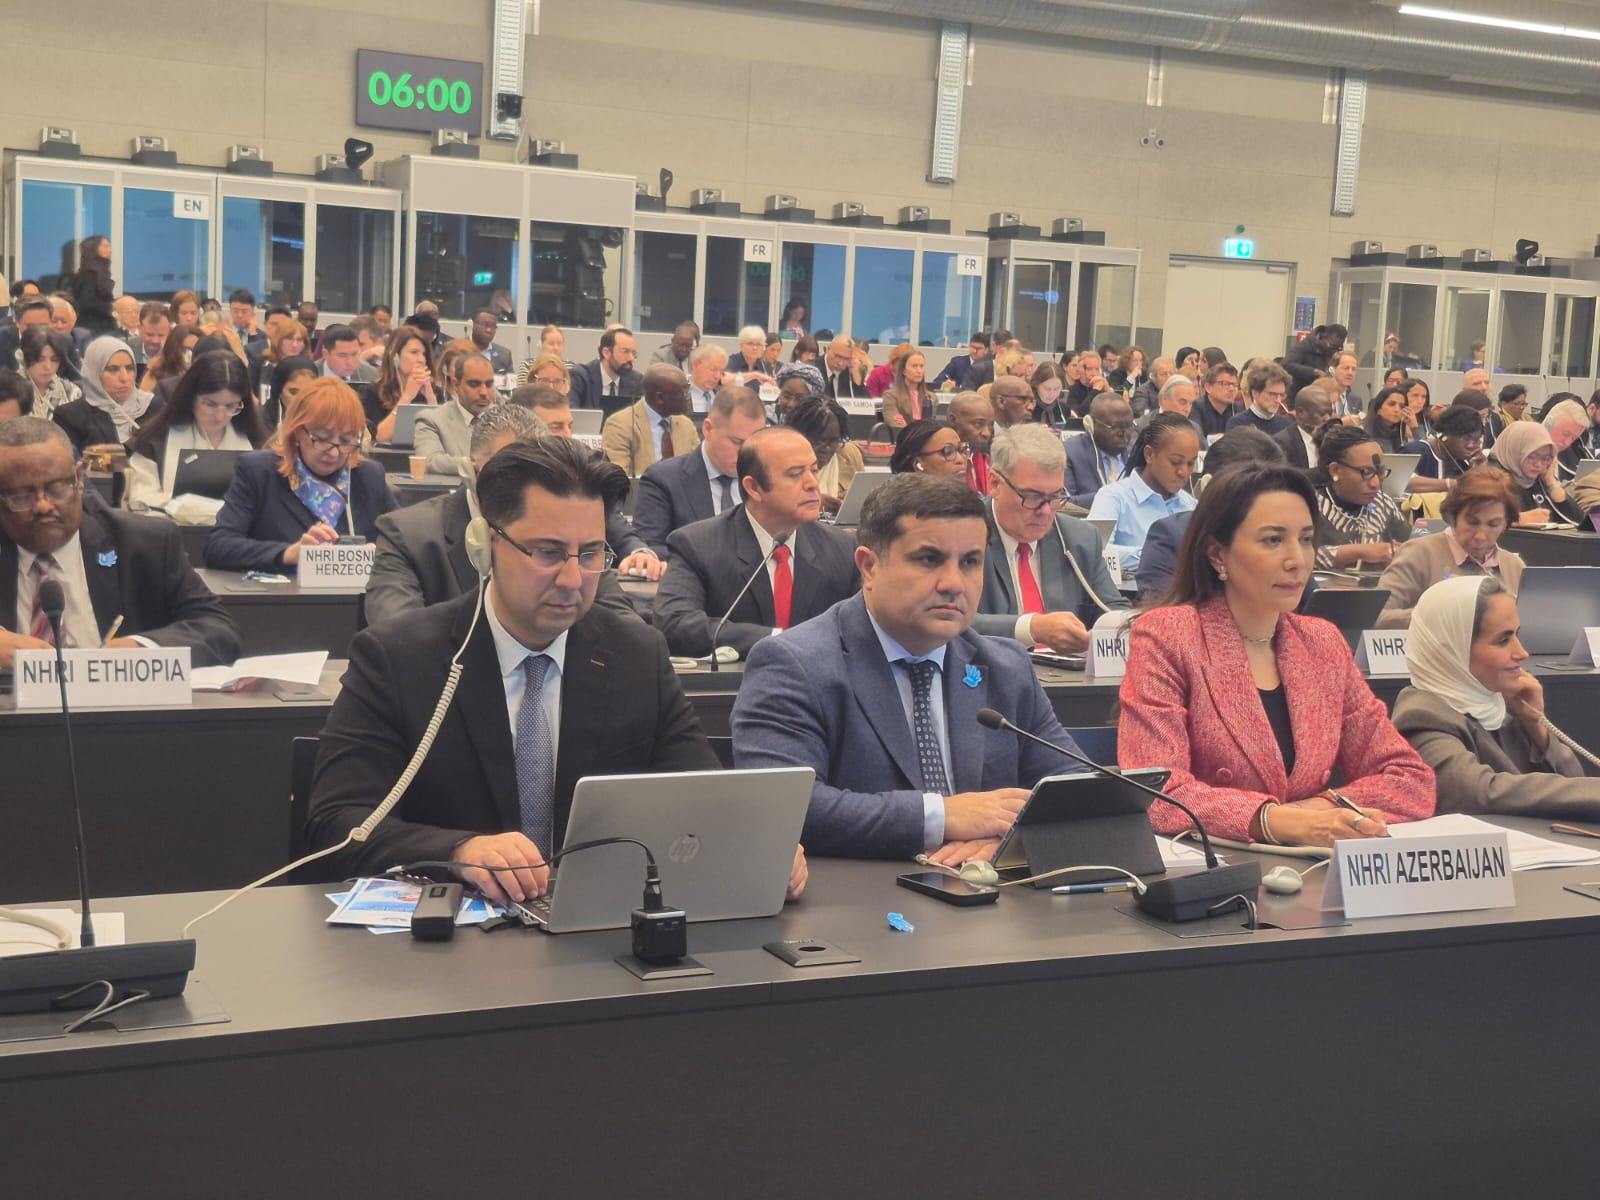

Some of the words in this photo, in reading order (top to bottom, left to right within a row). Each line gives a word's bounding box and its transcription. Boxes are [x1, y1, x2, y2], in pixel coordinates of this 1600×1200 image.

[368, 71, 472, 115] 06:00
[183, 199, 202, 213] EN
[752, 244, 766, 256] FR
[964, 258, 977, 270] FR
[306, 550, 335, 562] NHRI
[338, 550, 374, 562] BOSNI
[315, 564, 373, 576] HERZEGO
[1097, 638, 1126, 657] NHRI
[1372, 638, 1406, 656] NHR
[88, 658, 185, 682] ETHIOPIA
[1347, 852, 1391, 886] NHRI
[1397, 846, 1506, 883] AZERBAIJAN
